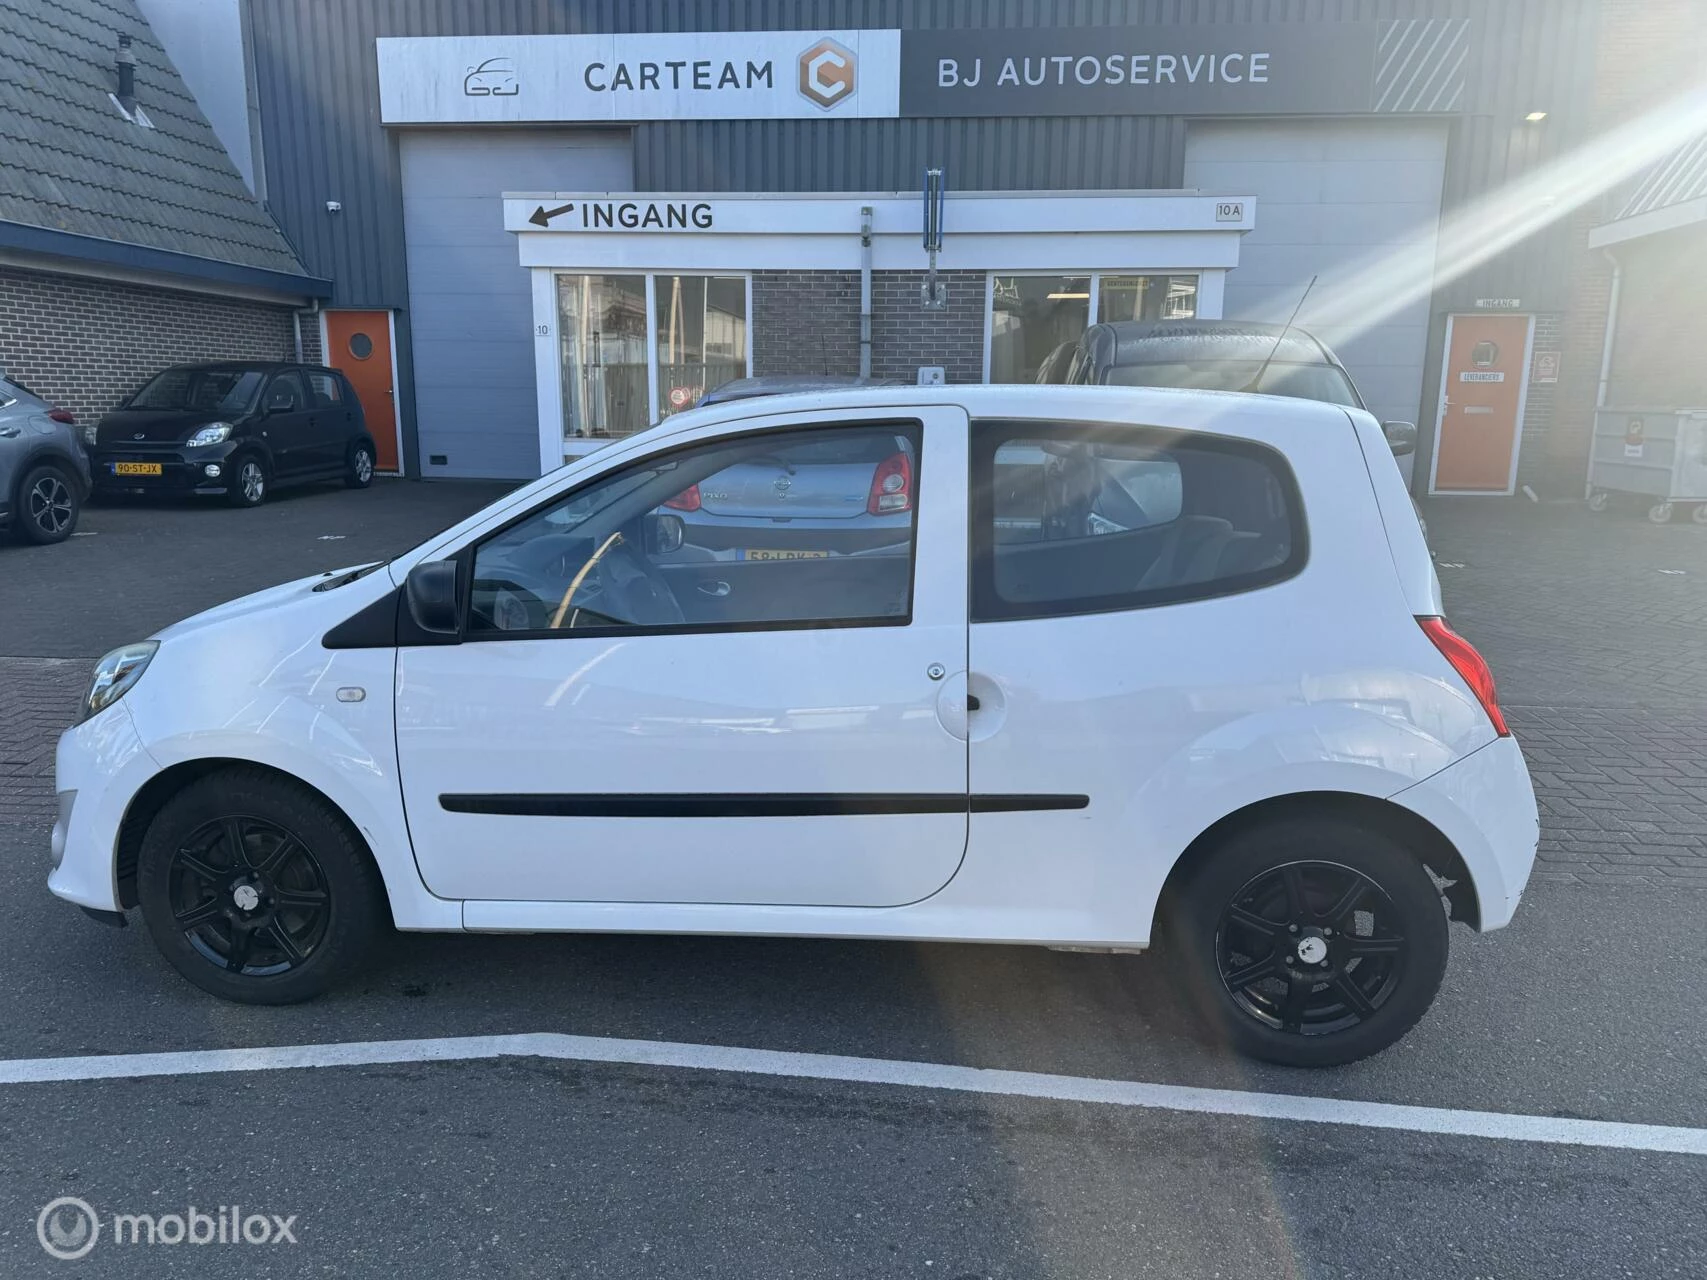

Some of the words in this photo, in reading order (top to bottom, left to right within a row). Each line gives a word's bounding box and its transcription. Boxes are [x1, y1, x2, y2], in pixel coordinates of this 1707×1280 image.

[584, 60, 773, 92] CARTEAM
[939, 59, 981, 87] BJ
[997, 53, 1270, 86] AUTOSERVICE
[583, 203, 713, 229] INGANG
[1219, 205, 1231, 216] 10
[1232, 205, 1241, 216] A
[538, 325, 548, 335] 10
[118, 464, 157, 473] 90-ST-JX
